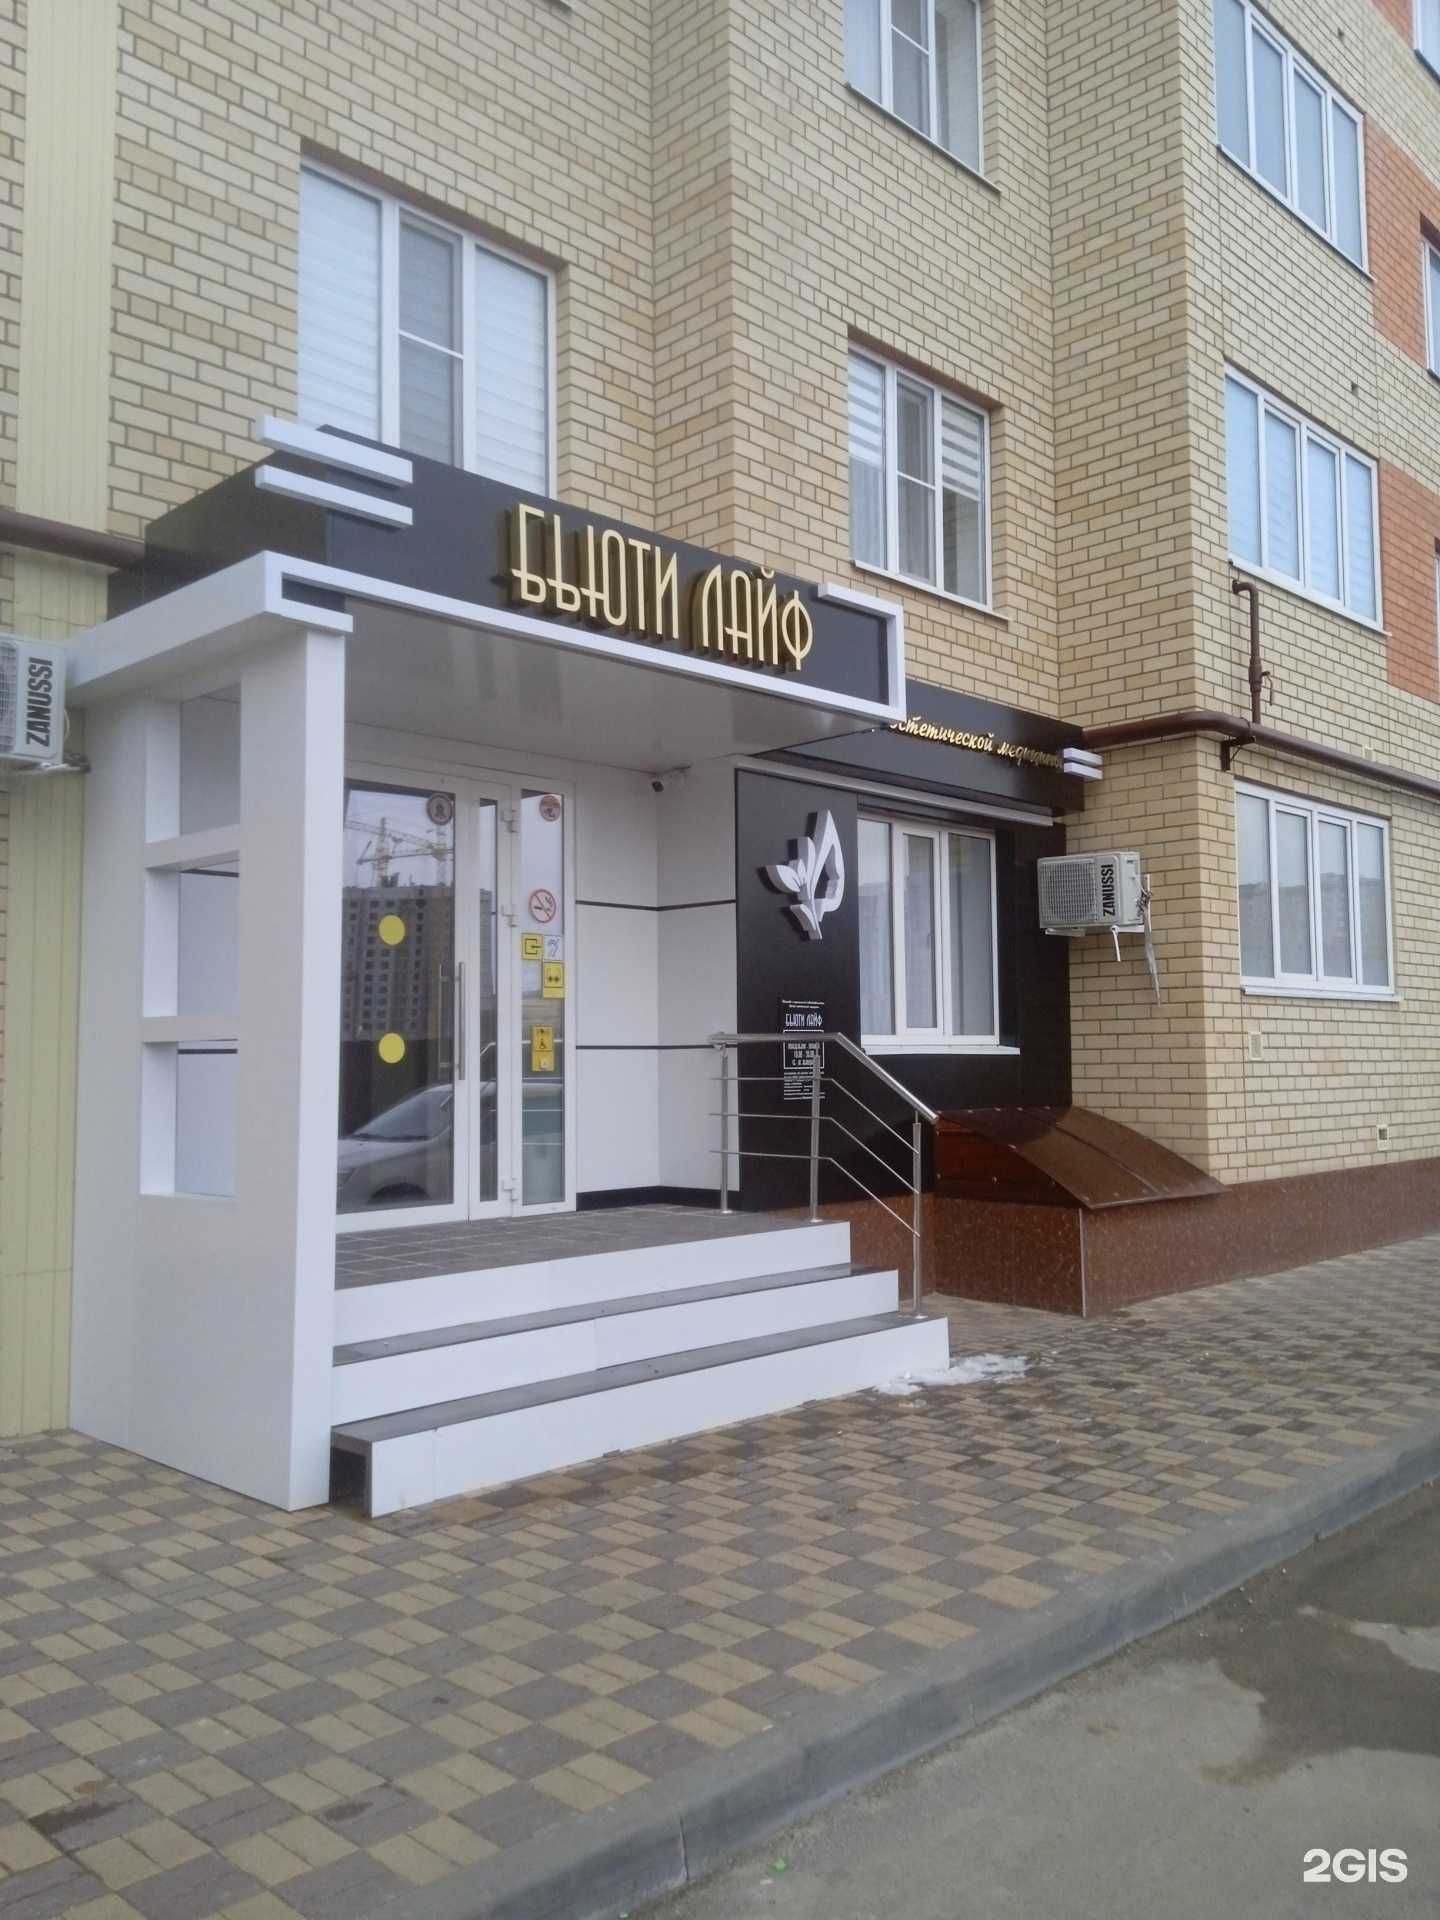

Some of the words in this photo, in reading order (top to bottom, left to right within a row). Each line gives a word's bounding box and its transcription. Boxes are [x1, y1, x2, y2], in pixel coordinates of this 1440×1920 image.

[511, 503, 679, 639] БЬЮТИ
[702, 564, 813, 671] ЛАЙФ
[25, 656, 53, 747] ZANUSSI
[1101, 864, 1115, 917] ZANUSSI
